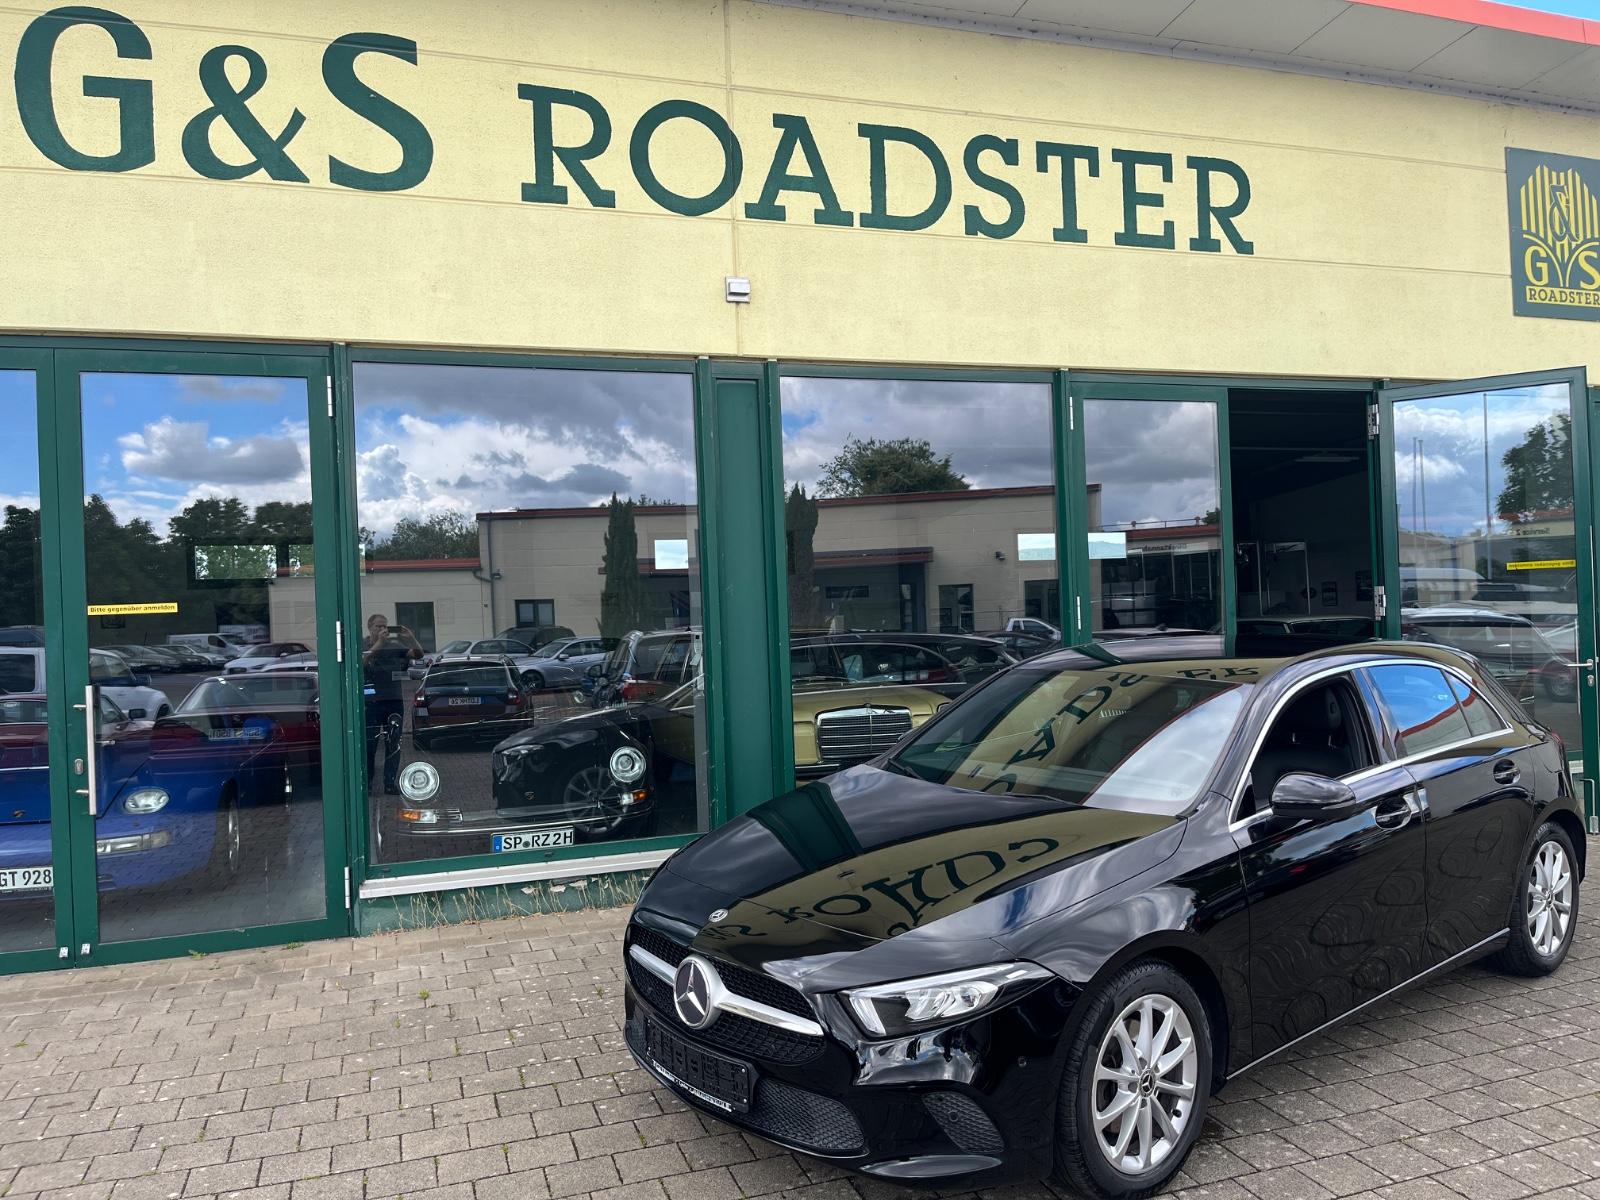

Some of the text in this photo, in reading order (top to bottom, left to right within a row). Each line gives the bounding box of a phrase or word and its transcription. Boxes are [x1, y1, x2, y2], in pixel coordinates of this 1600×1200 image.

[14, 6, 1254, 255] G&S ROADSTER
[1528, 288, 1600, 305] ROADSTER
[107, 605, 142, 613] gegenüber
[503, 837, 523, 850] SP
[0, 869, 52, 887] GT 928
